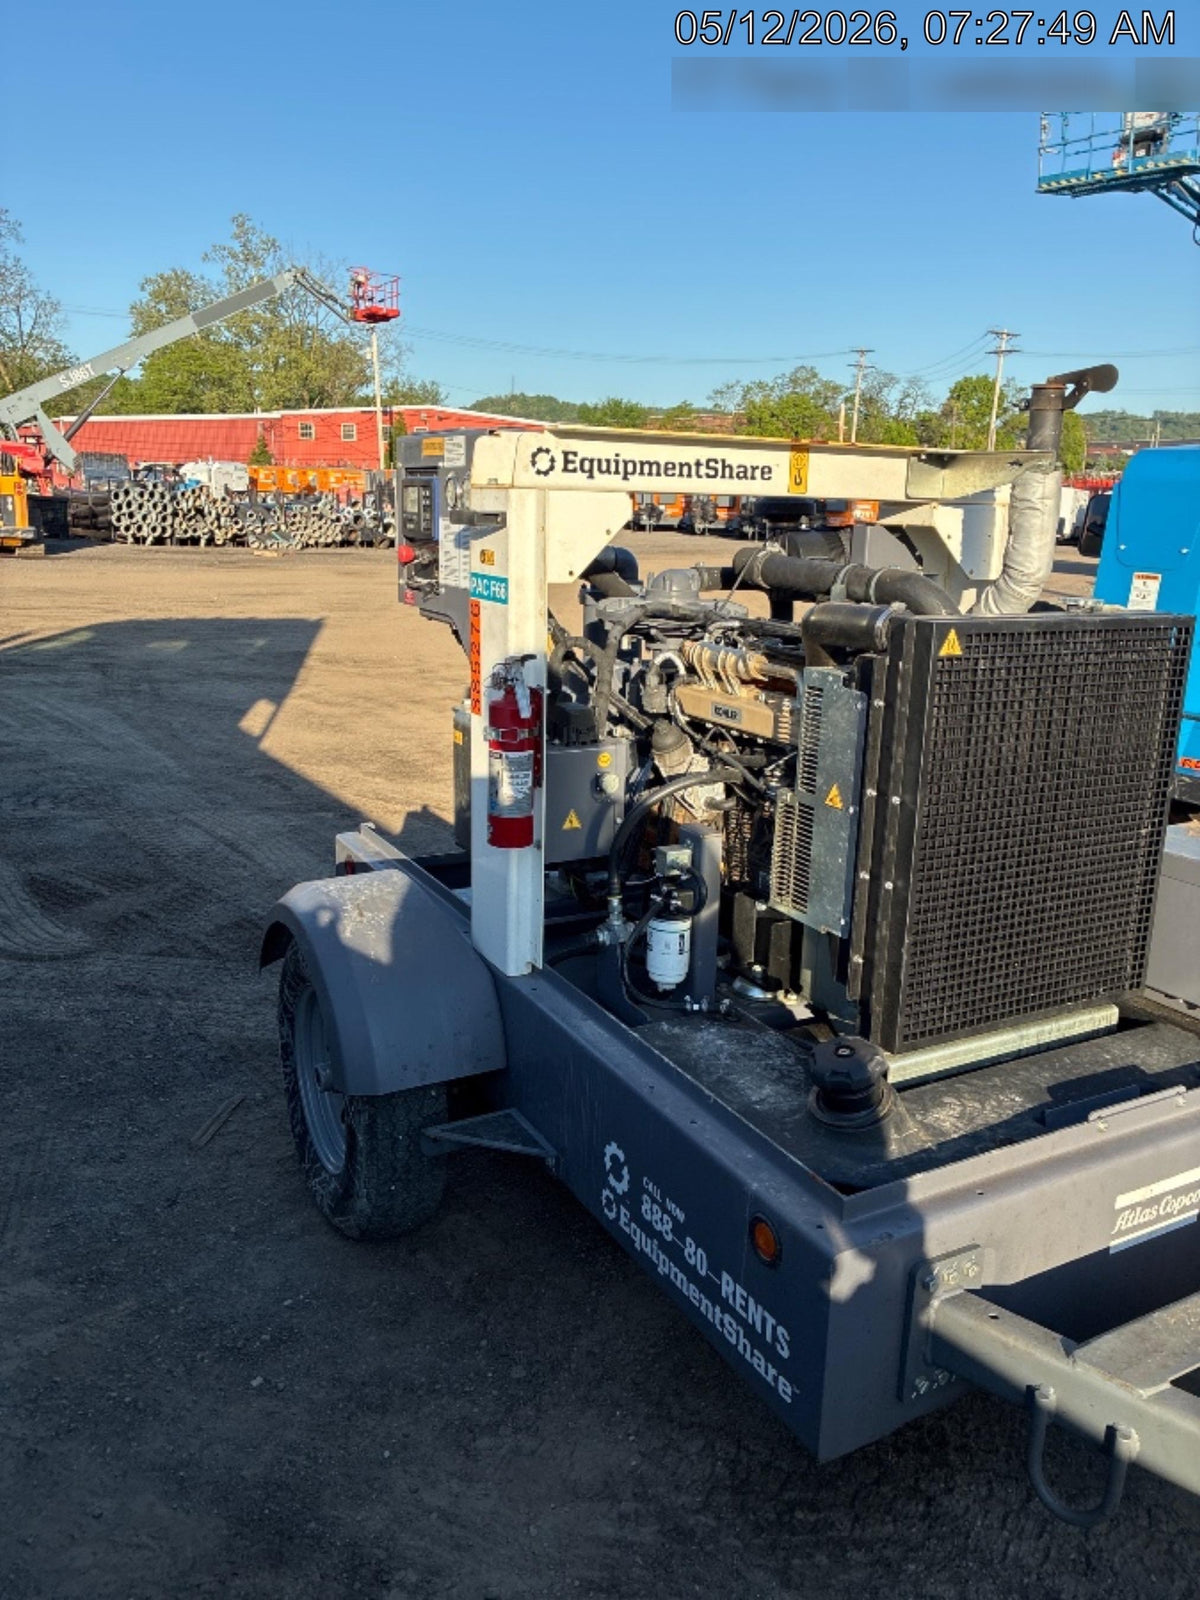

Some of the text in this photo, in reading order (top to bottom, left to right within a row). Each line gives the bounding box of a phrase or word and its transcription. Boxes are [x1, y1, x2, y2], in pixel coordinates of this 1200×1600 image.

[561, 450, 773, 481] EquipmentShare
[1110, 1204, 1159, 1235] Atlas
[618, 1203, 793, 1404] EquipmentShare
